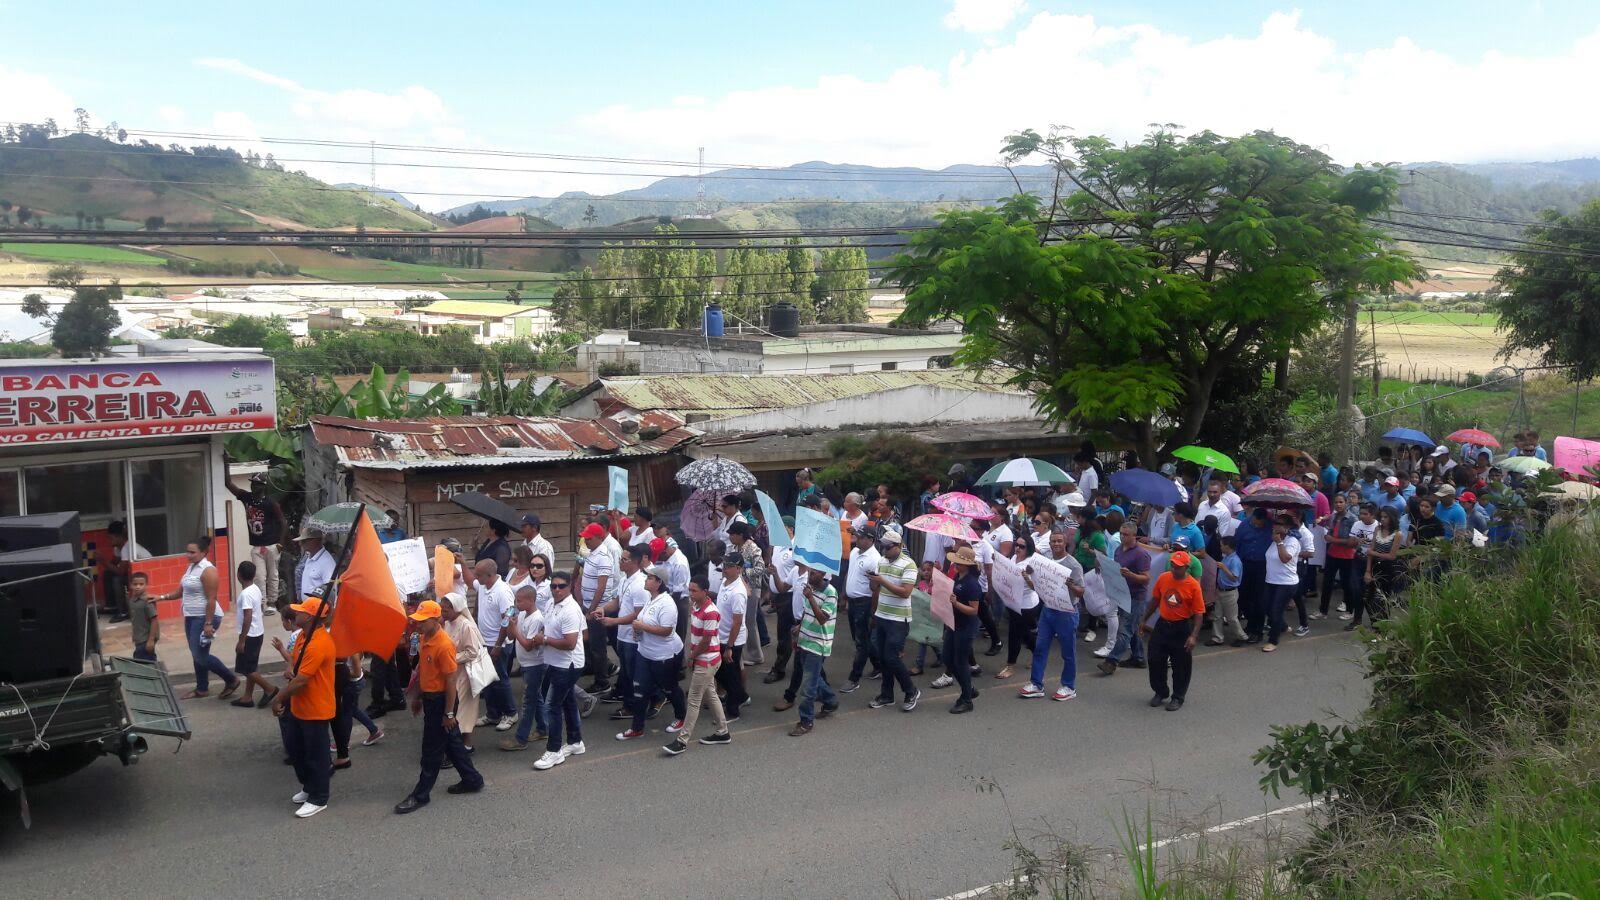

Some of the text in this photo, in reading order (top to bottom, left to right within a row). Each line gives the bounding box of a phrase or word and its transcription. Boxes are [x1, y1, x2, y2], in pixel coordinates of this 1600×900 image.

[2, 371, 162, 392] BANCA
[36, 427, 142, 441] CALIENTA
[149, 426, 176, 434] TU
[181, 421, 255, 433] DINERO
[499, 480, 560, 497] SANTOS
